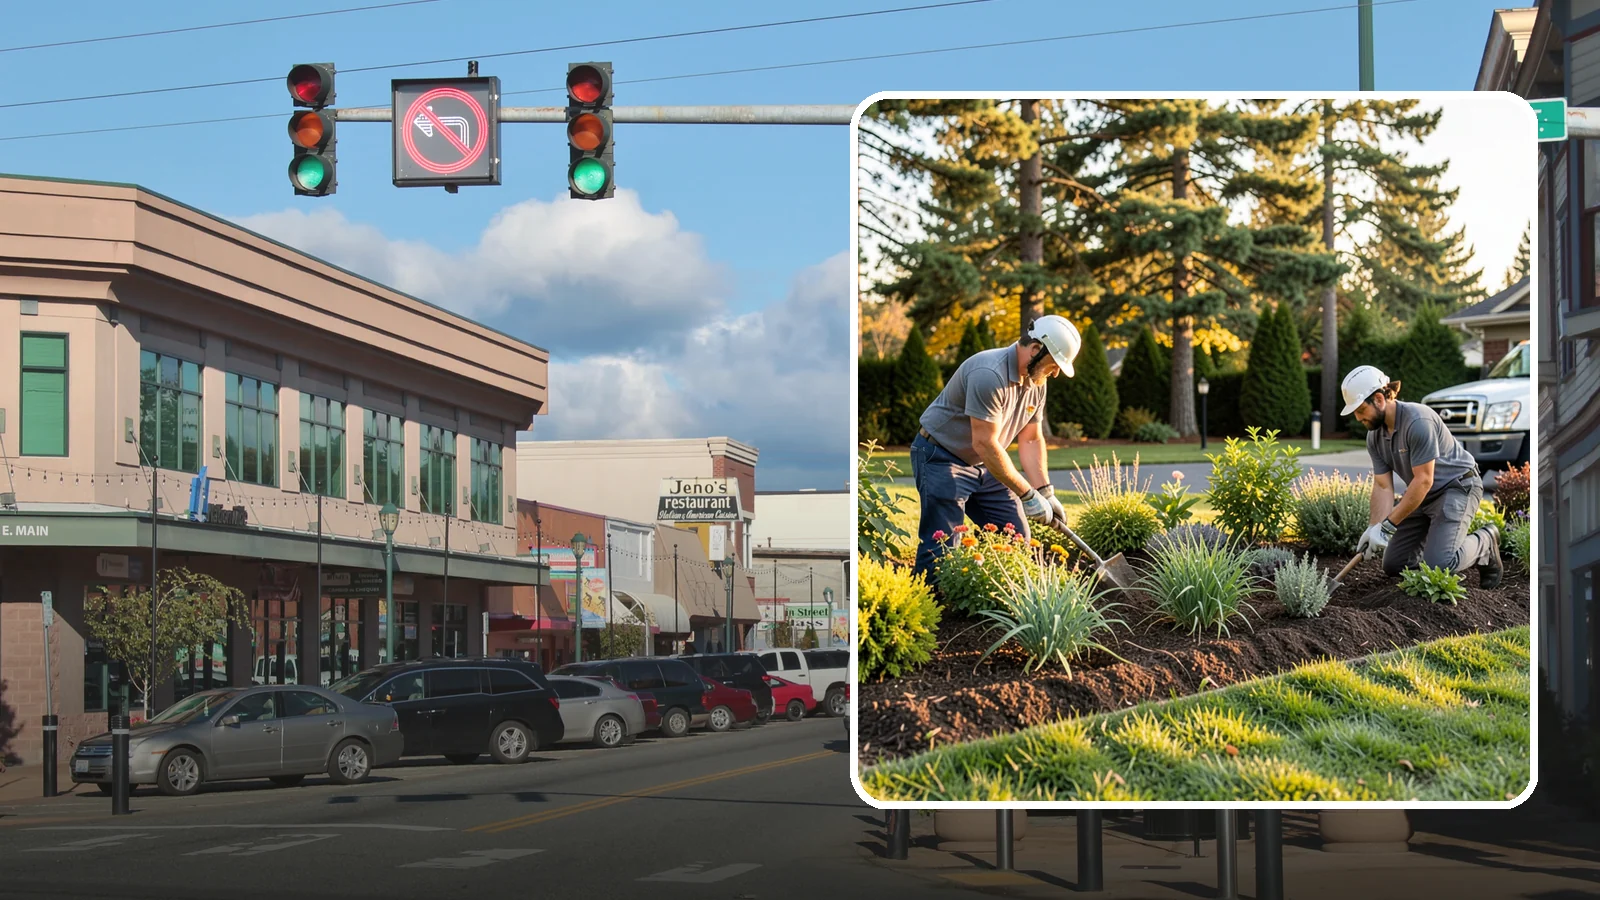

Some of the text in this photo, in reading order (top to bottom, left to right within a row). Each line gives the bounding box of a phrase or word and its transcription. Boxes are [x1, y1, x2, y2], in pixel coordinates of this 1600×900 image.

[670, 480, 727, 494] Jeno's
[665, 496, 731, 509] restaurant
[658, 510, 682, 520] Italian
[686, 510, 714, 520] American
[715, 509, 738, 520] Cuisine
[2, 525, 49, 536] E. MAIN
[786, 607, 795, 617] in
[797, 607, 828, 616] Street
[791, 619, 823, 627] lass
